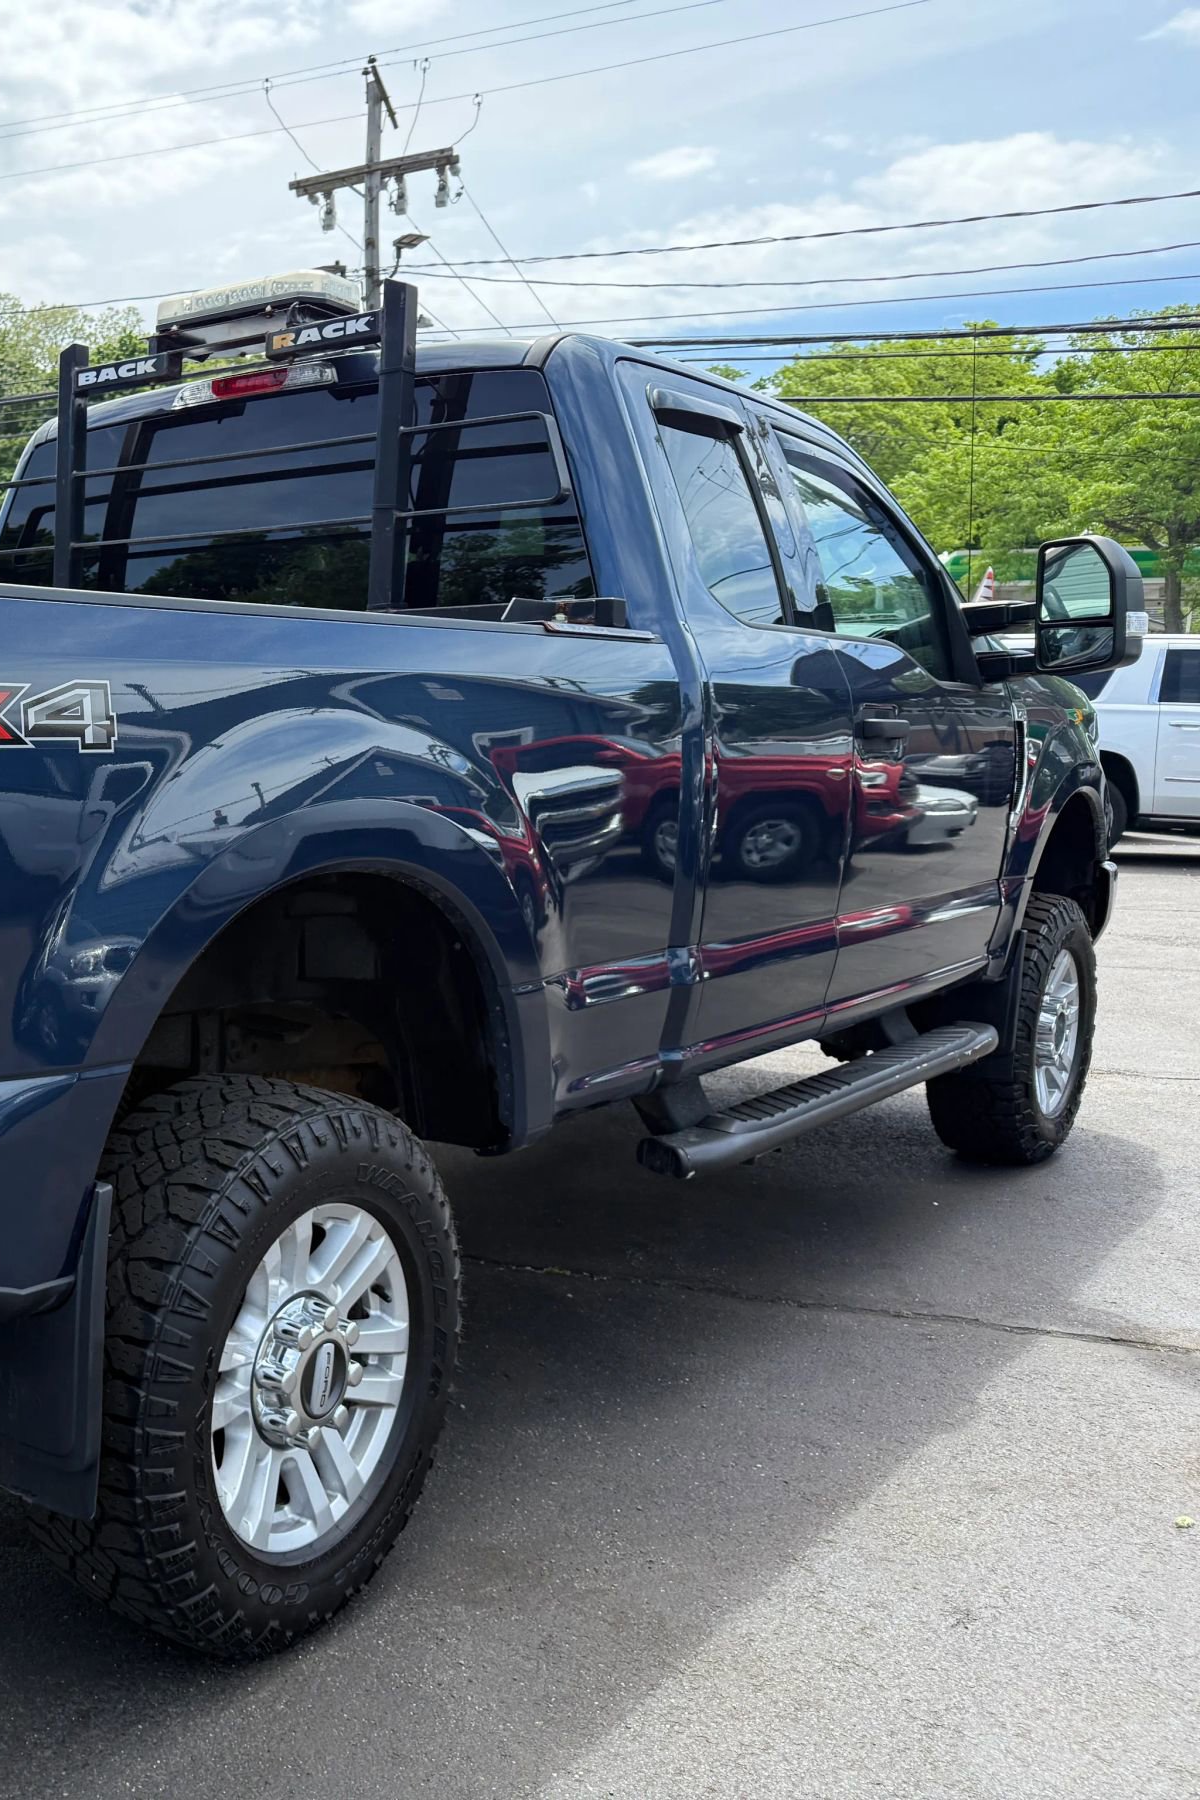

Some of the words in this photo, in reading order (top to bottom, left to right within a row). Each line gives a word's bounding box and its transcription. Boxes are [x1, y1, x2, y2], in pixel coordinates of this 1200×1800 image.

[77, 357, 157, 387] BACK
[272, 316, 371, 350] RACK
[356, 1161, 449, 1401] WRANGLER
[319, 1351, 332, 1408] FORD
